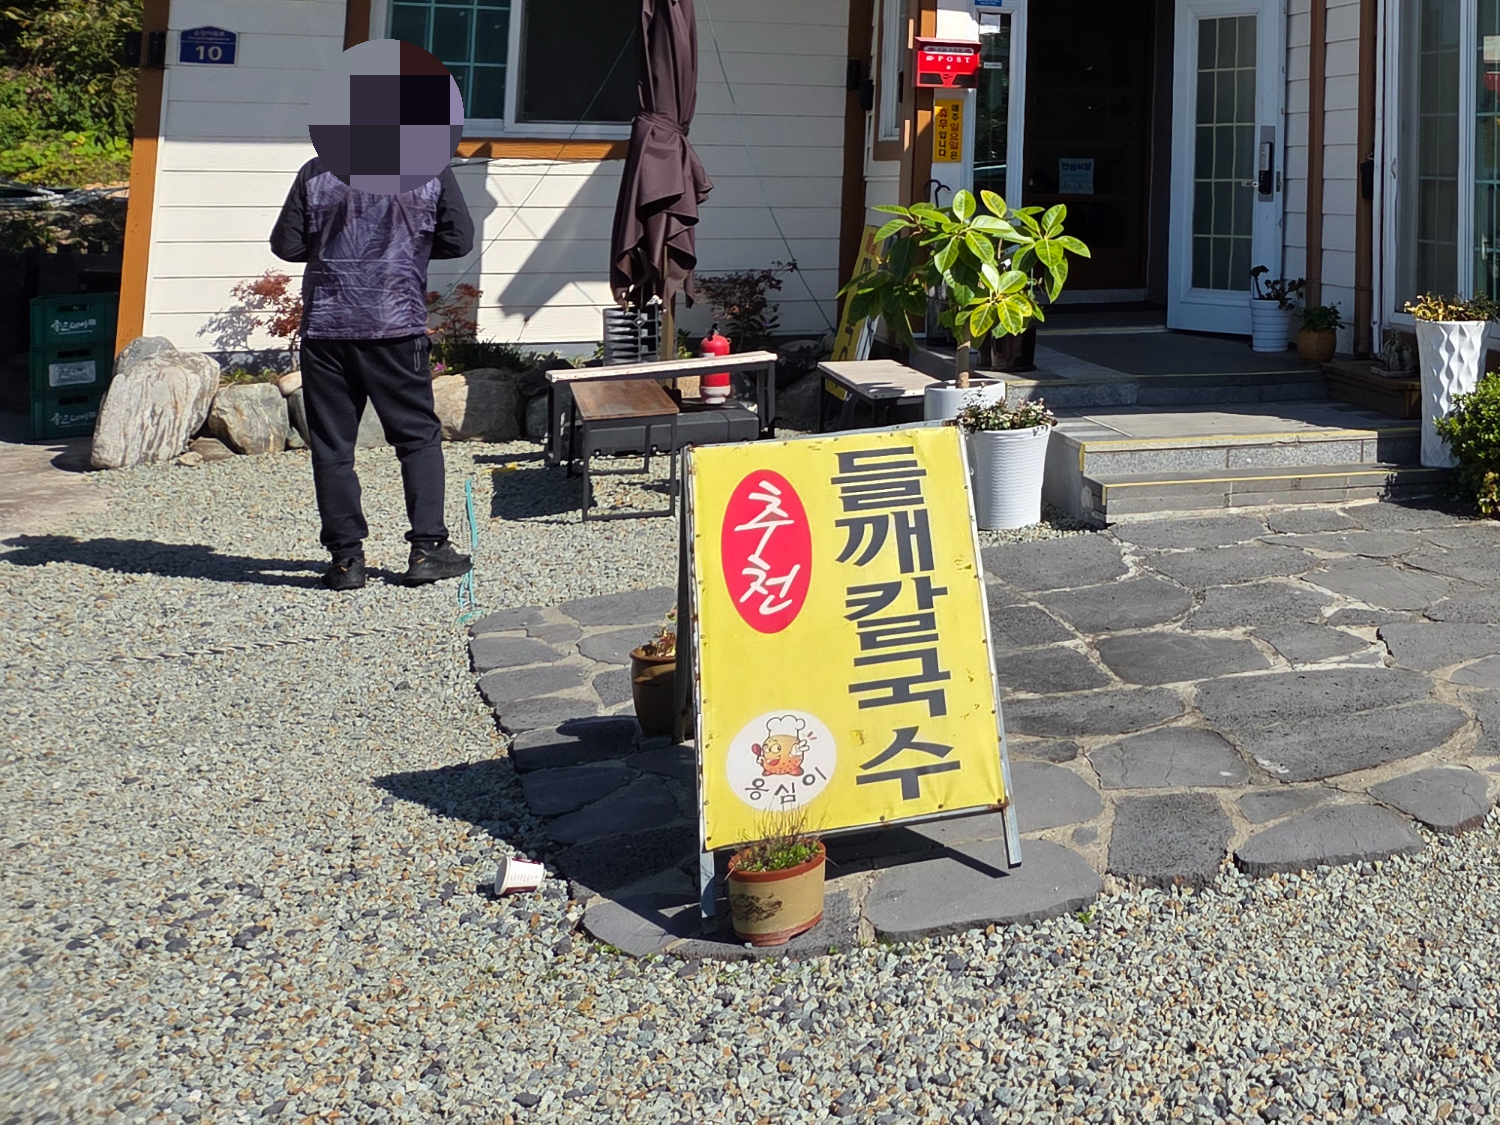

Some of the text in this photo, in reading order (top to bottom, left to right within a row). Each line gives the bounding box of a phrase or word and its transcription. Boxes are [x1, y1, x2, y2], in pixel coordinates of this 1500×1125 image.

[195, 45, 223, 61] 10
[937, 55, 972, 64] POST
[938, 107, 949, 157] 휴무입니다
[733, 479, 801, 616] 추천
[830, 446, 961, 801] 들깨칼국수
[744, 766, 827, 805] 옹심이
